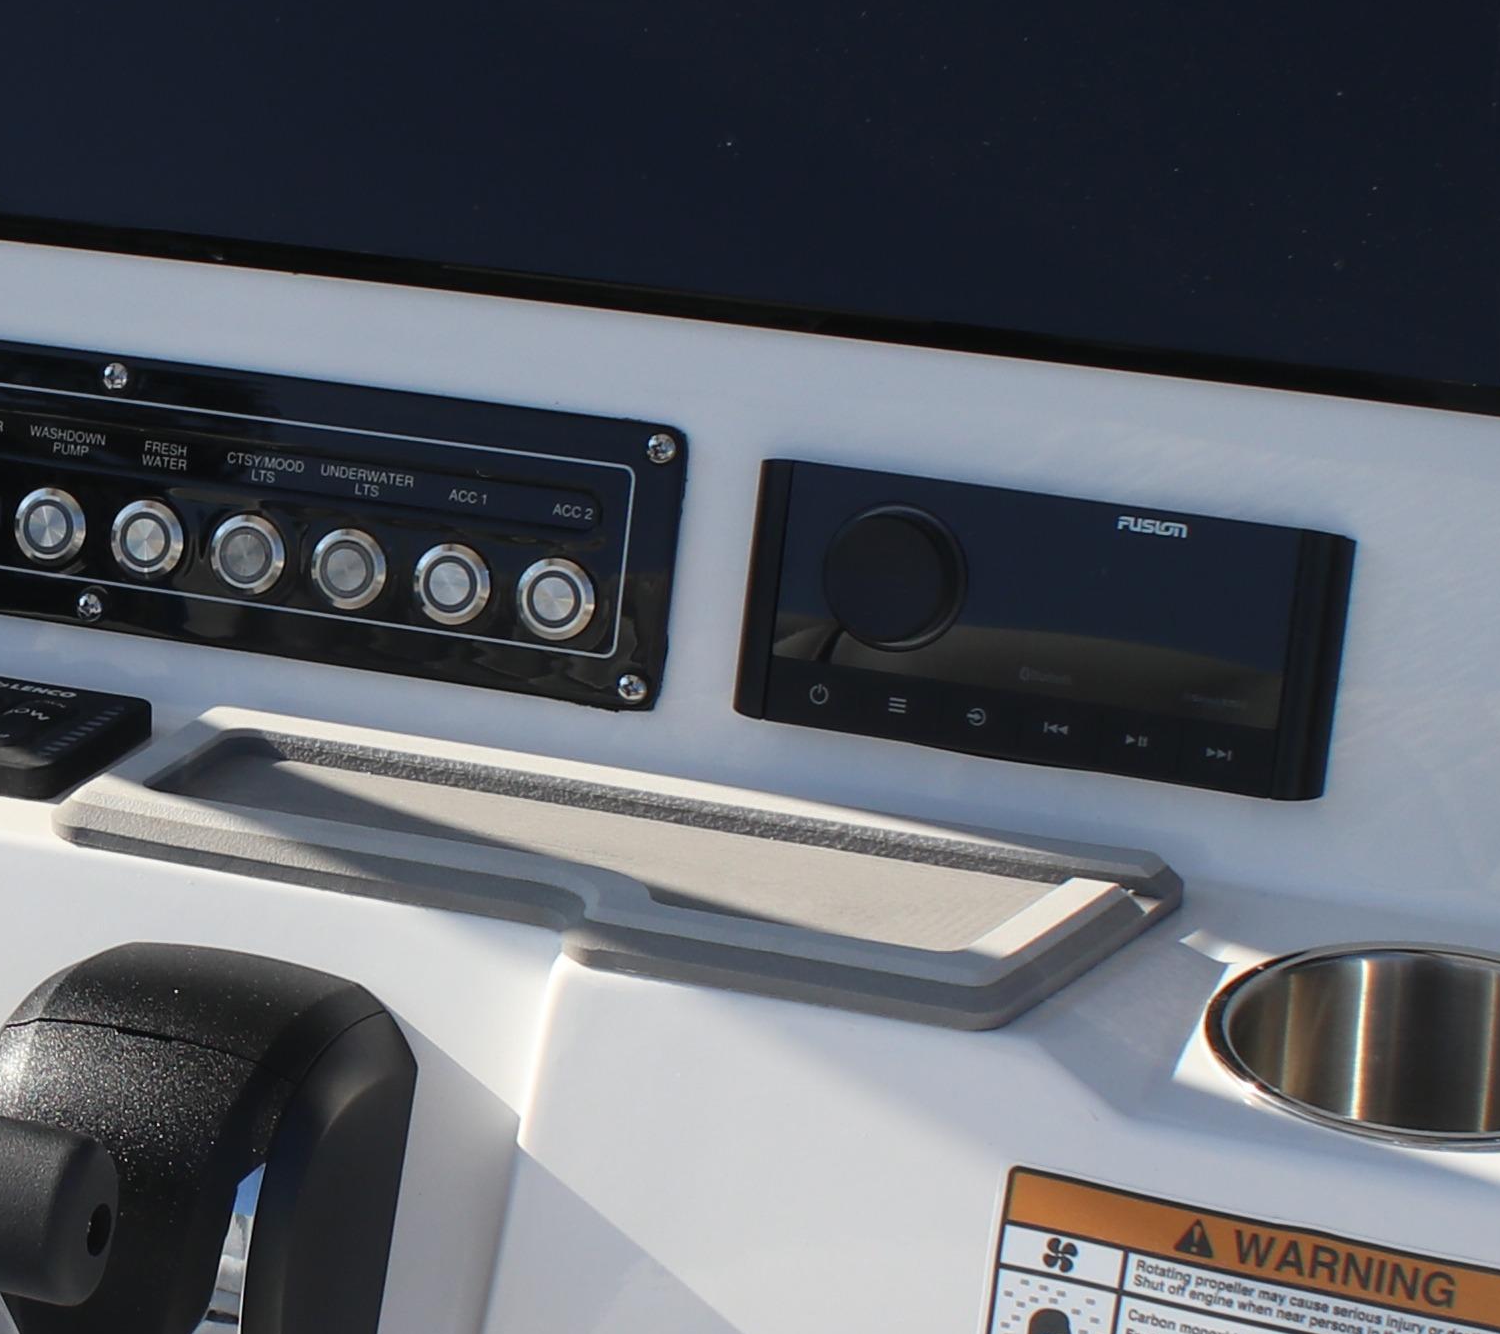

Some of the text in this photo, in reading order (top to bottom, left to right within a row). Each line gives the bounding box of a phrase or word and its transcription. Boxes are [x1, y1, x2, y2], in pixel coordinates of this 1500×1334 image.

[29, 424, 107, 447] WASHDOWN
[52, 440, 90, 458] PUMP
[144, 439, 188, 459] FRESH
[141, 452, 188, 472] WATER
[226, 450, 305, 475] CTSY/MOOD
[250, 468, 276, 485] LTS
[320, 463, 415, 490] UNDERWATER
[354, 481, 380, 499] LTS
[448, 487, 488, 506] ACC 1
[552, 501, 594, 521] ACC 2
[1116, 514, 1188, 539] FUSION
[8, 682, 77, 699] LENCO
[1231, 1226, 1456, 1311] WARNING
[1131, 1272, 1167, 1293] Shut
[1165, 1282, 1188, 1297] off
[1186, 1289, 1235, 1308] engine
[1235, 1298, 1274, 1317] when
[1274, 1308, 1308, 1324] near
[1134, 1258, 1193, 1287] Rotating
[1192, 1275, 1257, 1297] propeller
[1256, 1288, 1288, 1308] may
[1287, 1295, 1331, 1314] cause
[1330, 1305, 1385, 1326] serious
[1126, 1307, 1177, 1331] Carbon
